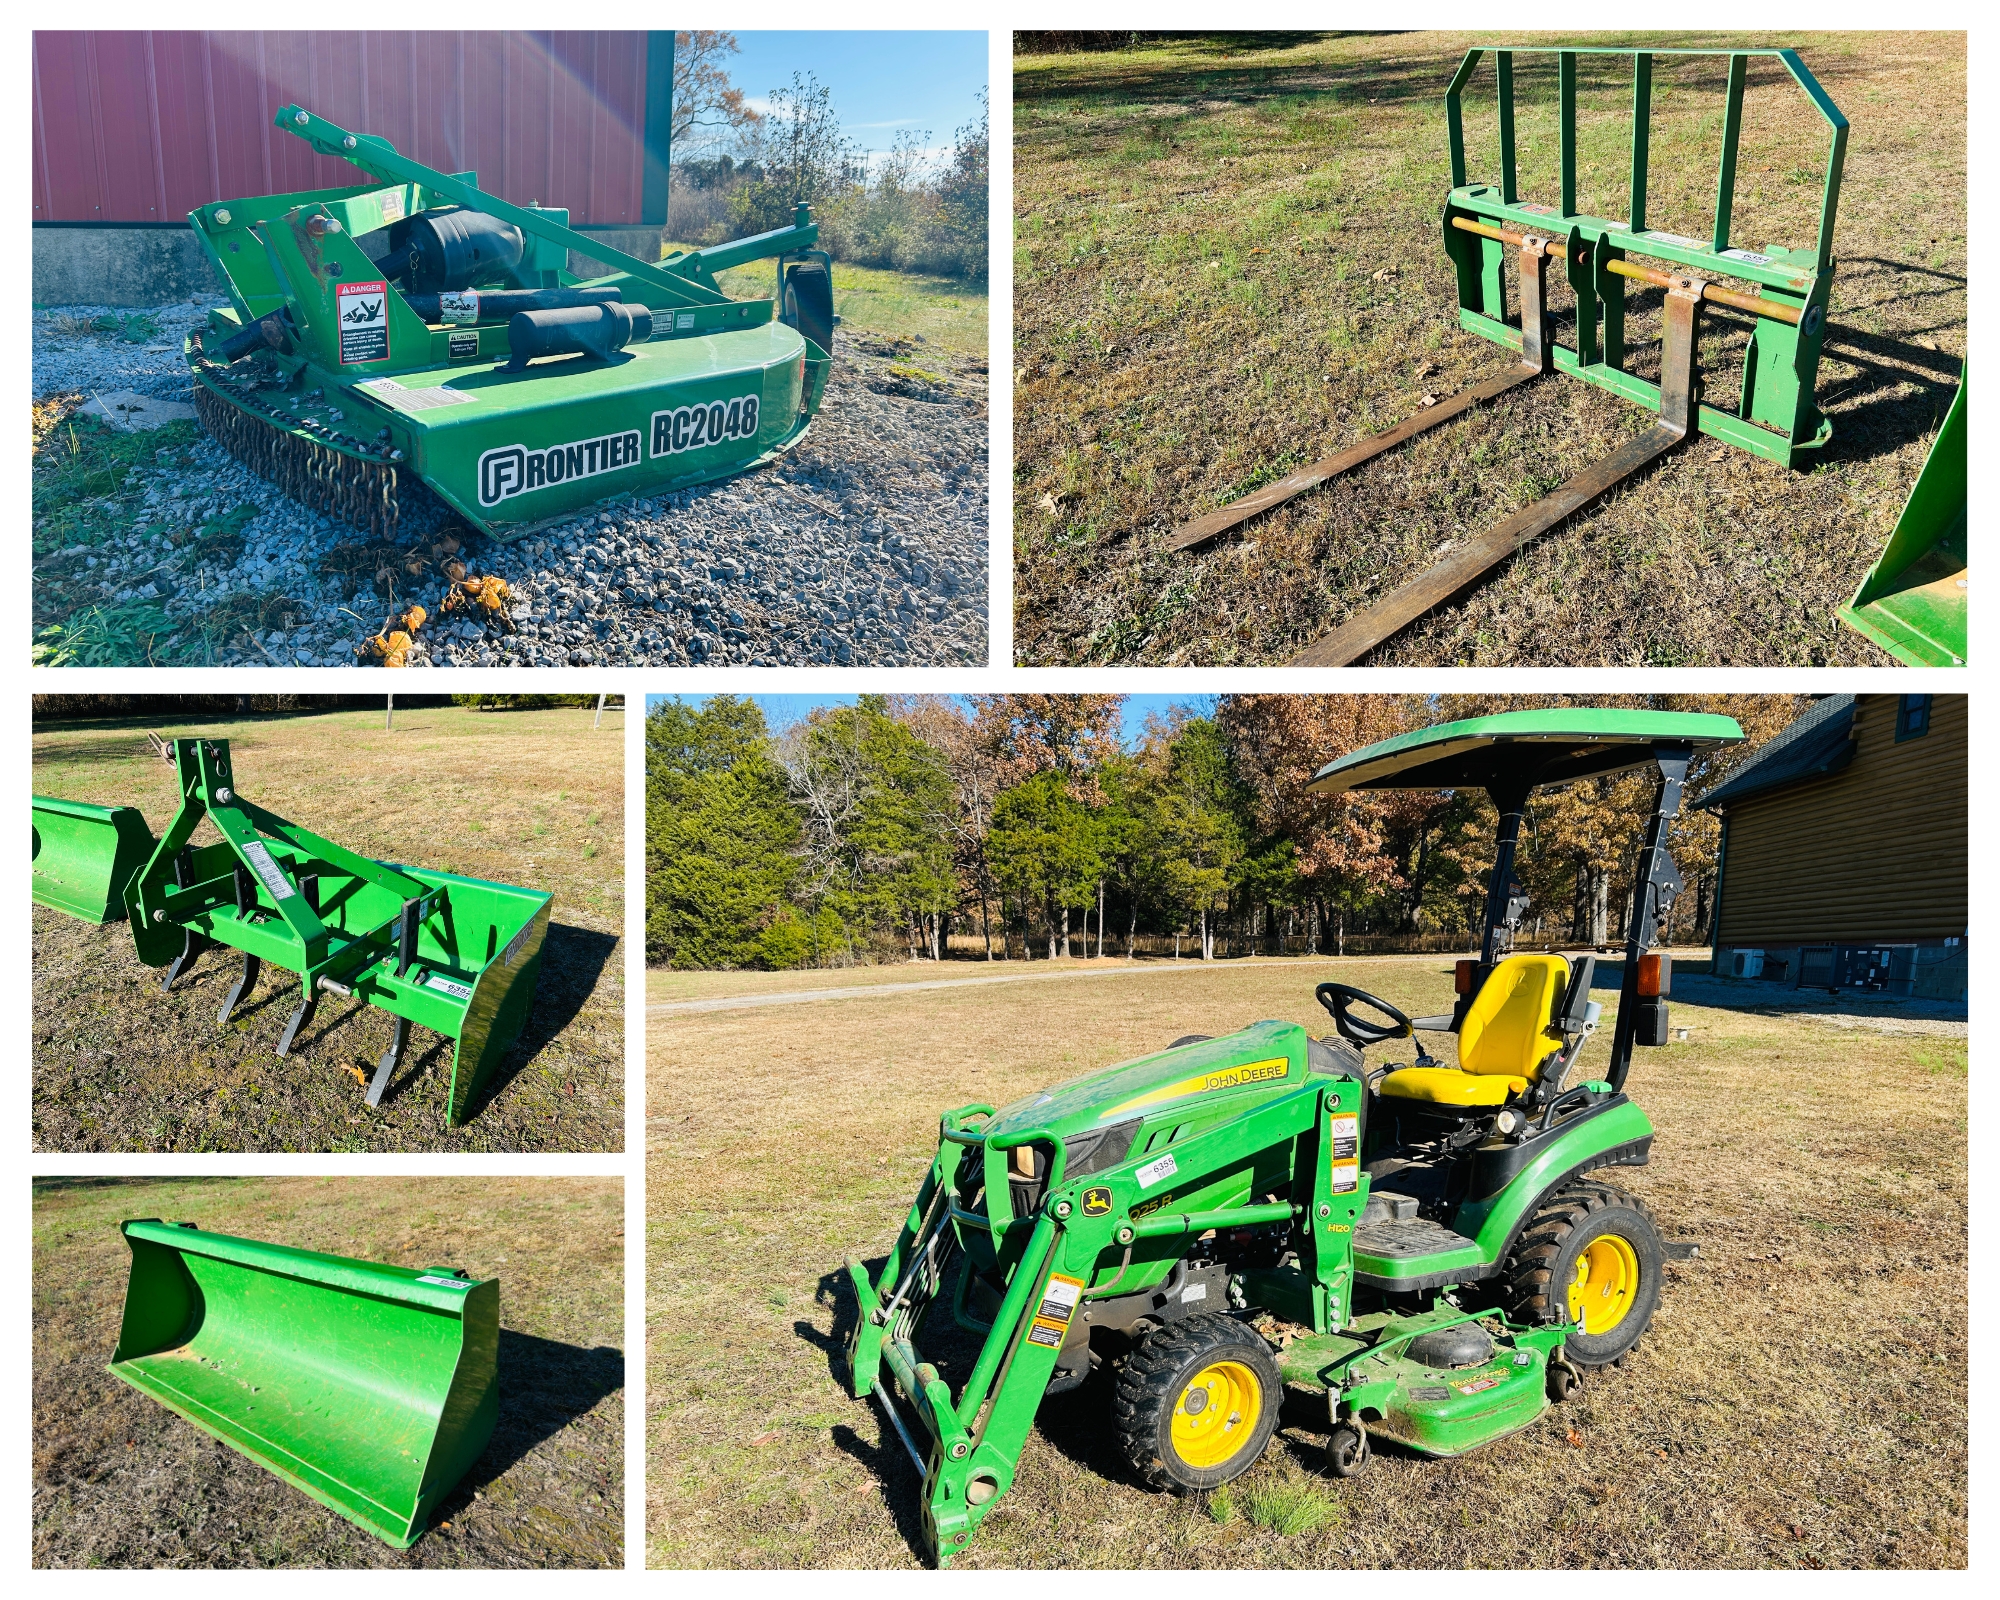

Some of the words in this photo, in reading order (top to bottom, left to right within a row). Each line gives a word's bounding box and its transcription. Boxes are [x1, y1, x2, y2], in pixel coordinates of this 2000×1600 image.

[350, 285, 381, 293] DANGER
[481, 431, 641, 504] FRONTIER
[653, 397, 758, 456] RC2048
[1202, 1073, 1239, 1091] JOHN
[1241, 1065, 1283, 1082] DEERE
[1153, 1157, 1174, 1173] 6355
[1327, 1223, 1351, 1233] H120
